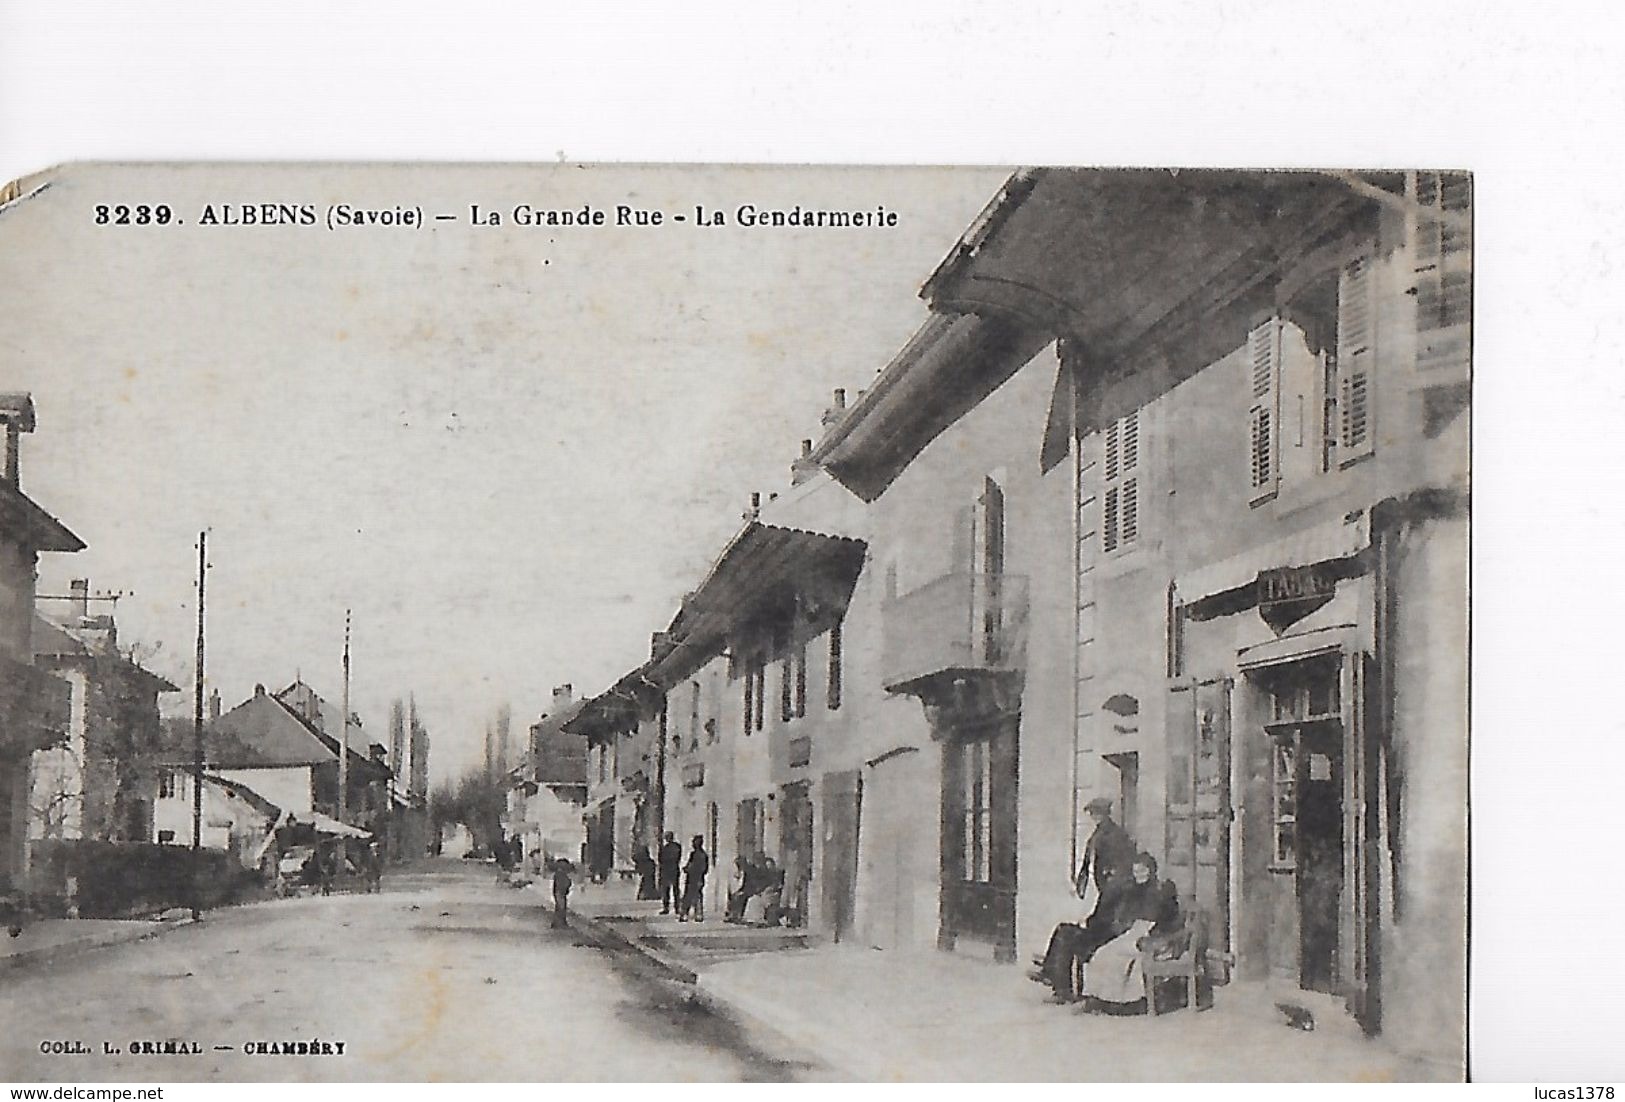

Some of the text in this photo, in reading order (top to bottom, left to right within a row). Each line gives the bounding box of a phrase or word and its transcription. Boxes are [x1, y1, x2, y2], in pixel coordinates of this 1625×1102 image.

[95, 205, 184, 225] 3239.
[198, 205, 316, 225] ALBENS
[327, 205, 422, 231] (Savoie)
[471, 205, 501, 226] La
[513, 205, 605, 226] Grande
[616, 205, 663, 226] Rue
[695, 205, 725, 227] La
[737, 205, 897, 227] Gendarmerie
[40, 1040, 92, 1054] COLL.
[103, 1041, 121, 1055] L.
[129, 1040, 203, 1055] GRIMAL
[244, 1038, 345, 1055] CHAMBÉRY
